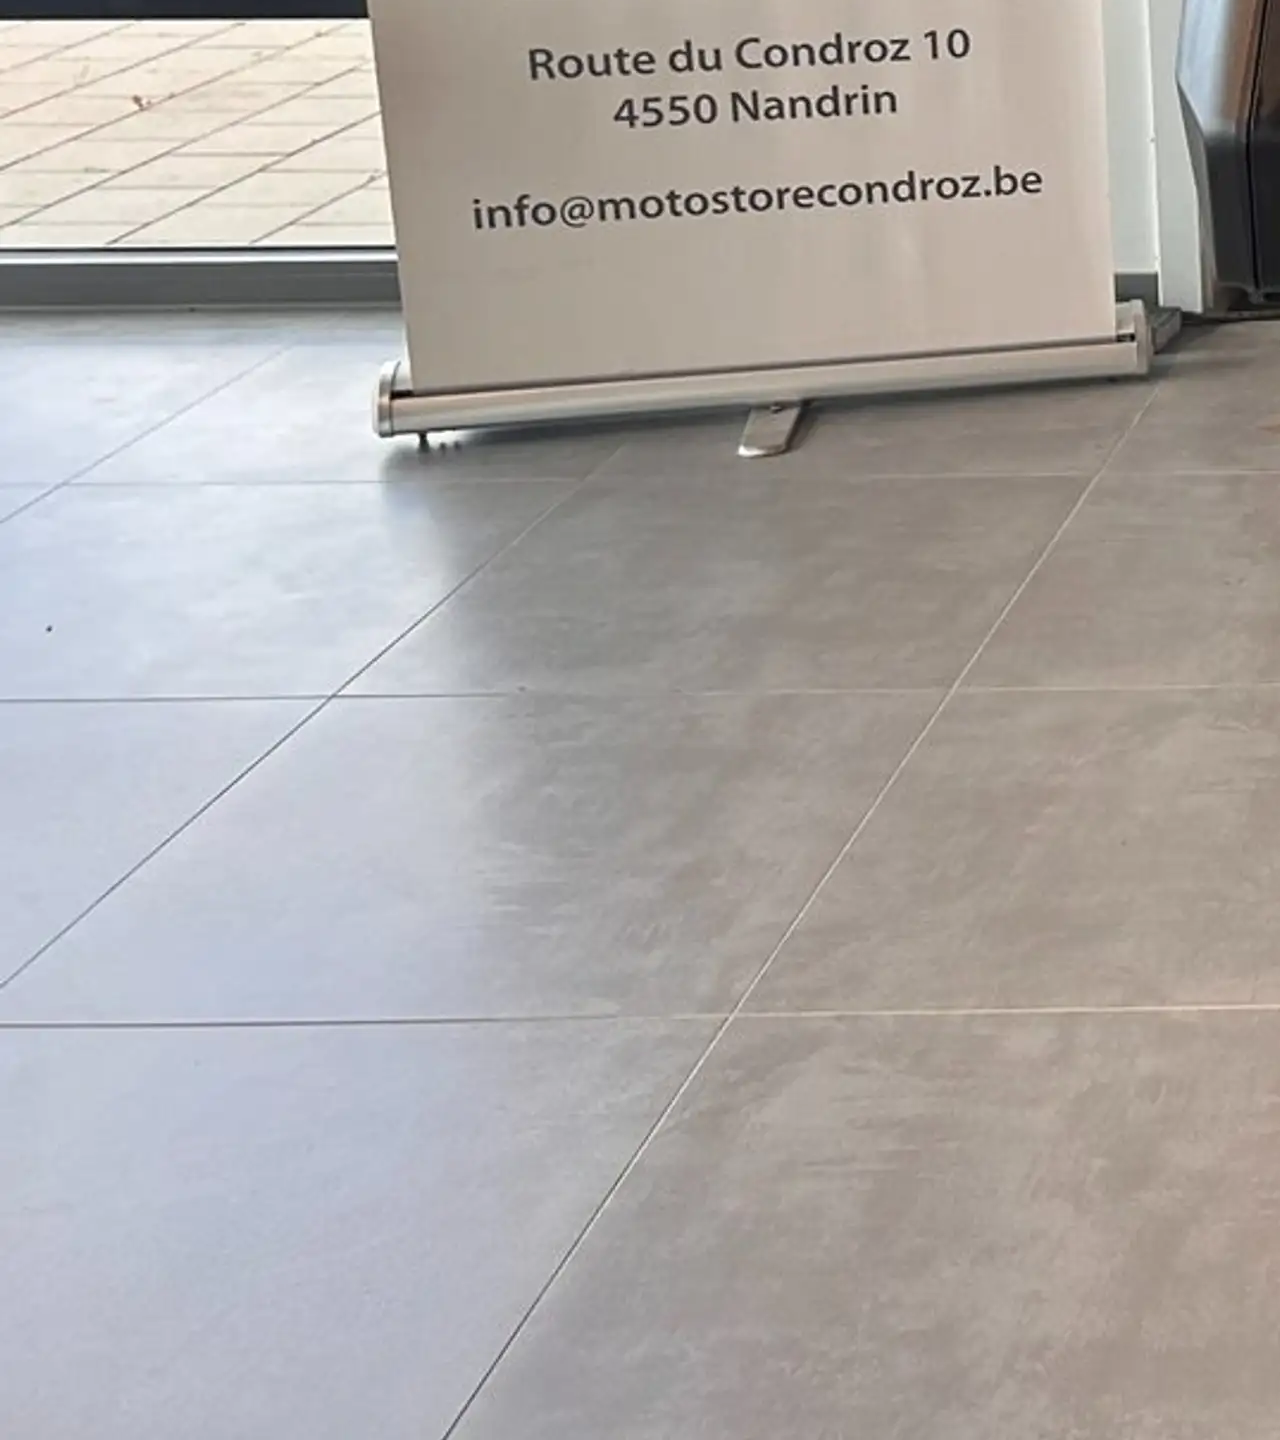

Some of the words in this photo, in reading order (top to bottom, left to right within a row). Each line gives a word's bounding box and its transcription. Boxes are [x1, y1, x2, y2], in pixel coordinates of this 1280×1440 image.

[527, 46, 658, 82] Route
[667, 38, 724, 75] du
[733, 31, 912, 70] Condroz
[922, 27, 971, 61] 10
[612, 92, 719, 130] 4550
[729, 83, 898, 124] Nandrin
[471, 164, 1044, 231] info@motostorecondroz.be
